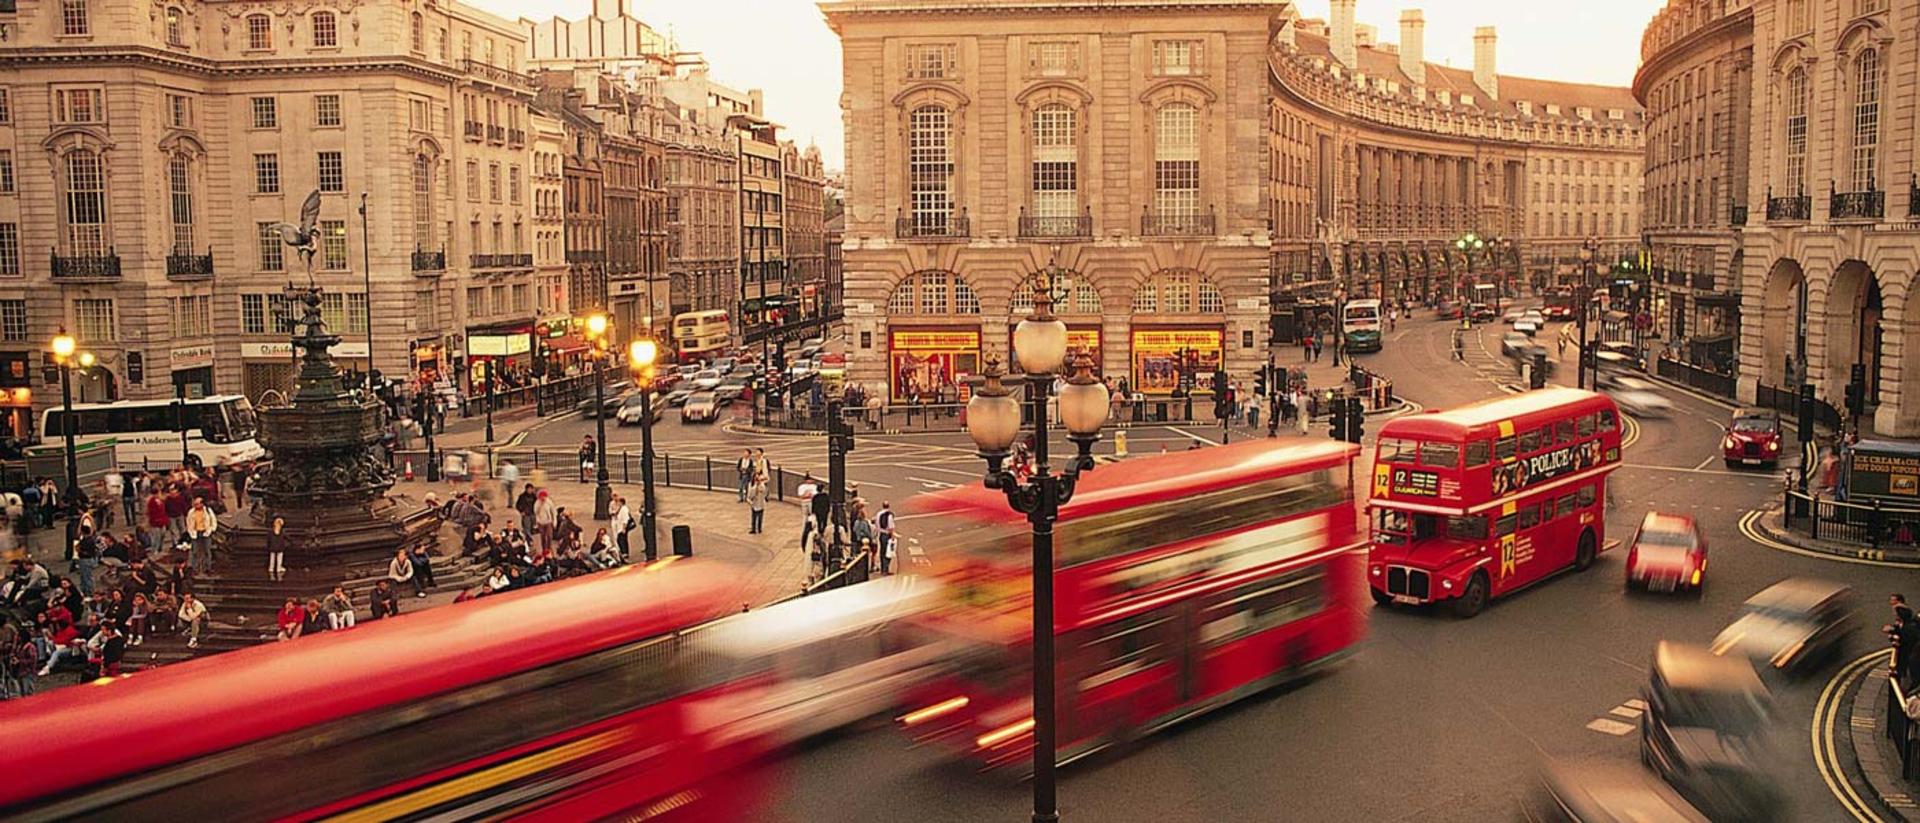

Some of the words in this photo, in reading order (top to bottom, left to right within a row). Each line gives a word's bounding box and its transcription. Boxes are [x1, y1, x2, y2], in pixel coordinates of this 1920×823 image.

[142, 437, 181, 445] Anderson
[1530, 448, 1570, 476] POLICE
[1377, 474, 1389, 487] 12
[1395, 471, 1407, 483] 12
[1504, 541, 1514, 563] 12
